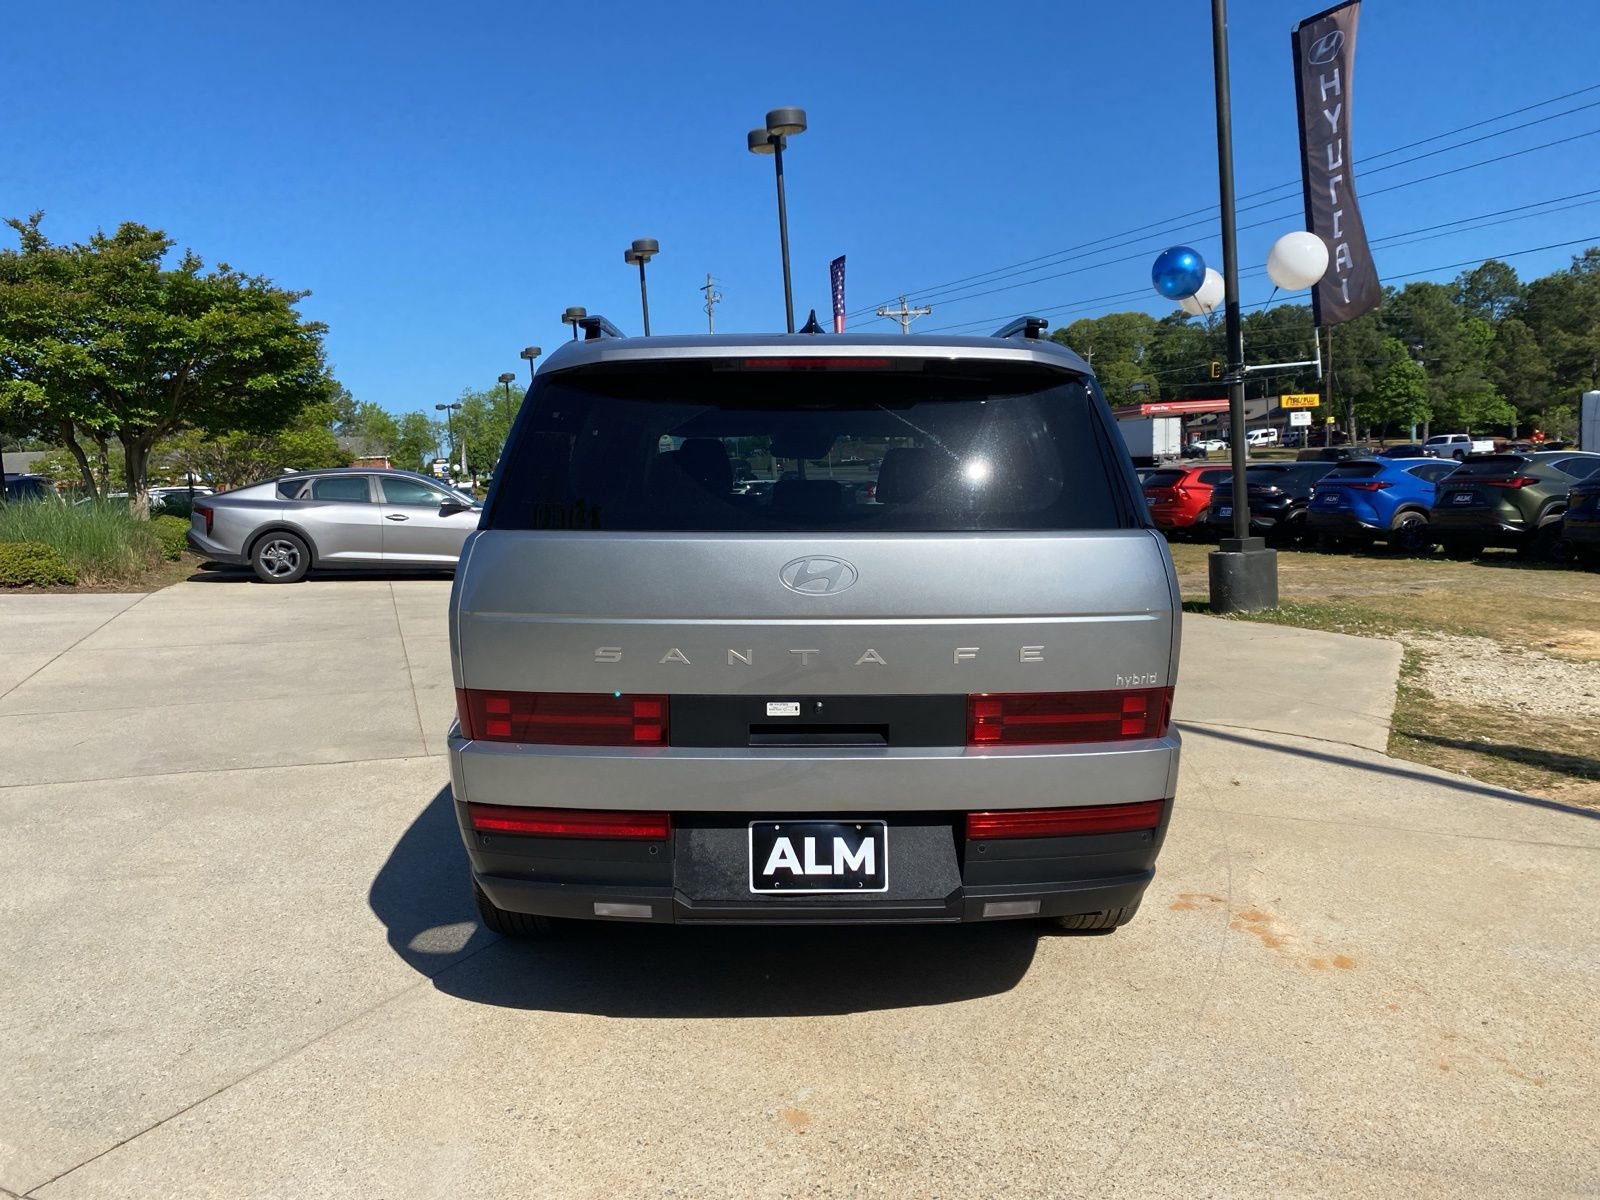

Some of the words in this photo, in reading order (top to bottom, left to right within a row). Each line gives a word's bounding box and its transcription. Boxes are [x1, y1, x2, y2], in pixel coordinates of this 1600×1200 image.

[594, 646, 887, 666] SANTA
[953, 647, 1045, 664] FE
[1115, 672, 1157, 688] hybrid
[762, 836, 875, 876] ALM
